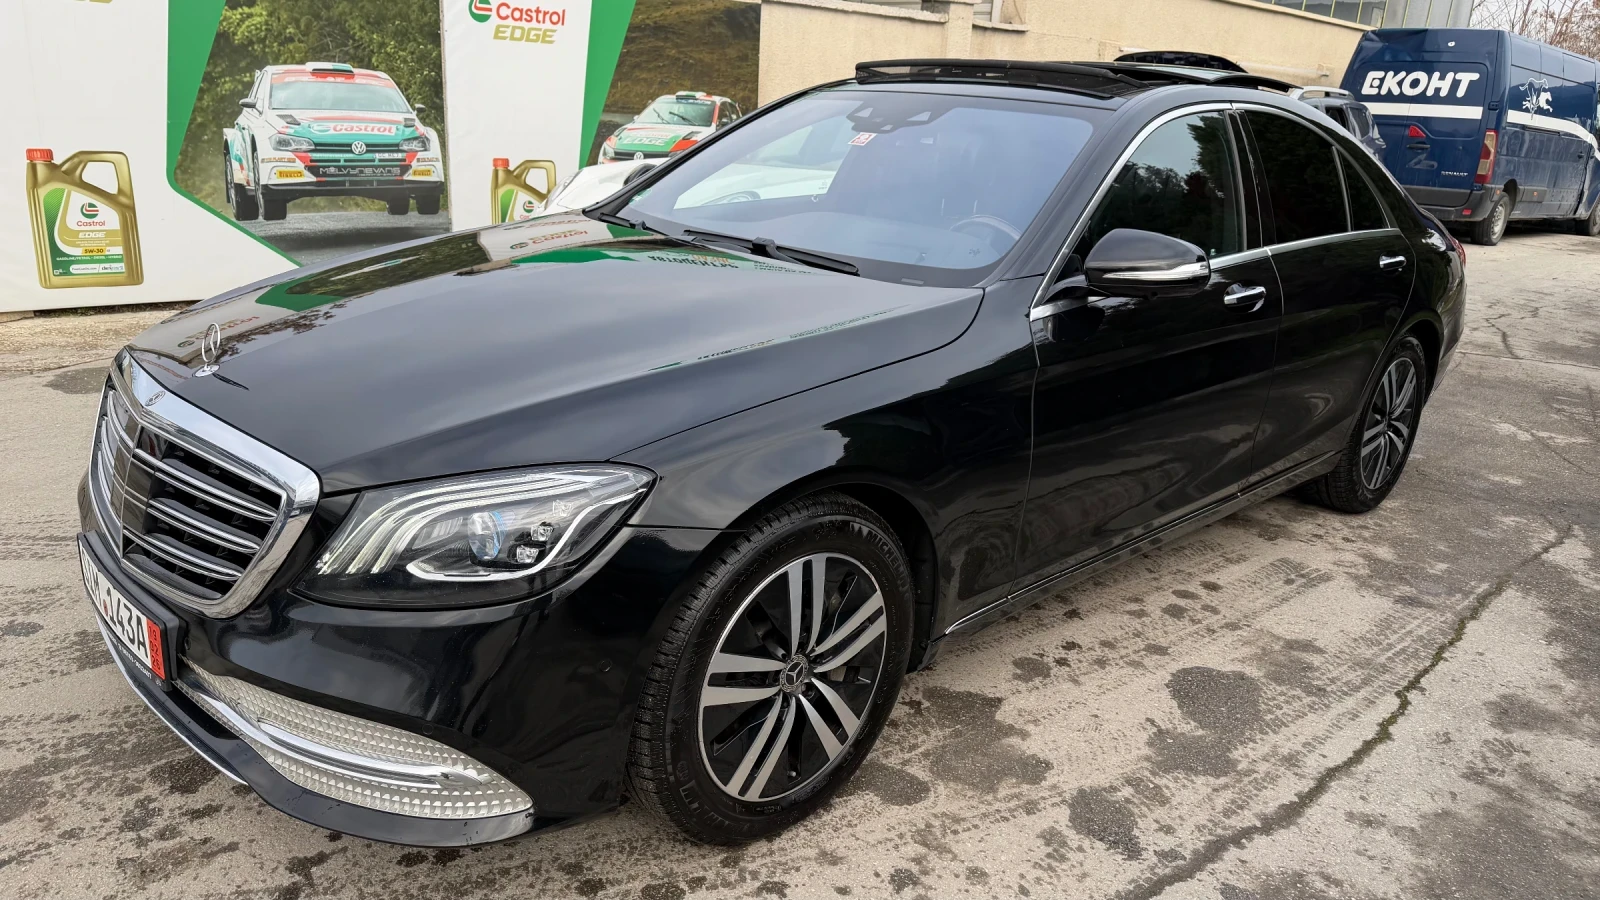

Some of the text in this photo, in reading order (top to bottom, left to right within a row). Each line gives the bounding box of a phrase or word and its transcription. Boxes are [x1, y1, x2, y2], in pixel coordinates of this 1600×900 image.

[495, 2, 566, 26] Castrol
[493, 24, 558, 44] EDGE
[332, 124, 395, 134] Castrol
[622, 137, 668, 146] EDGE
